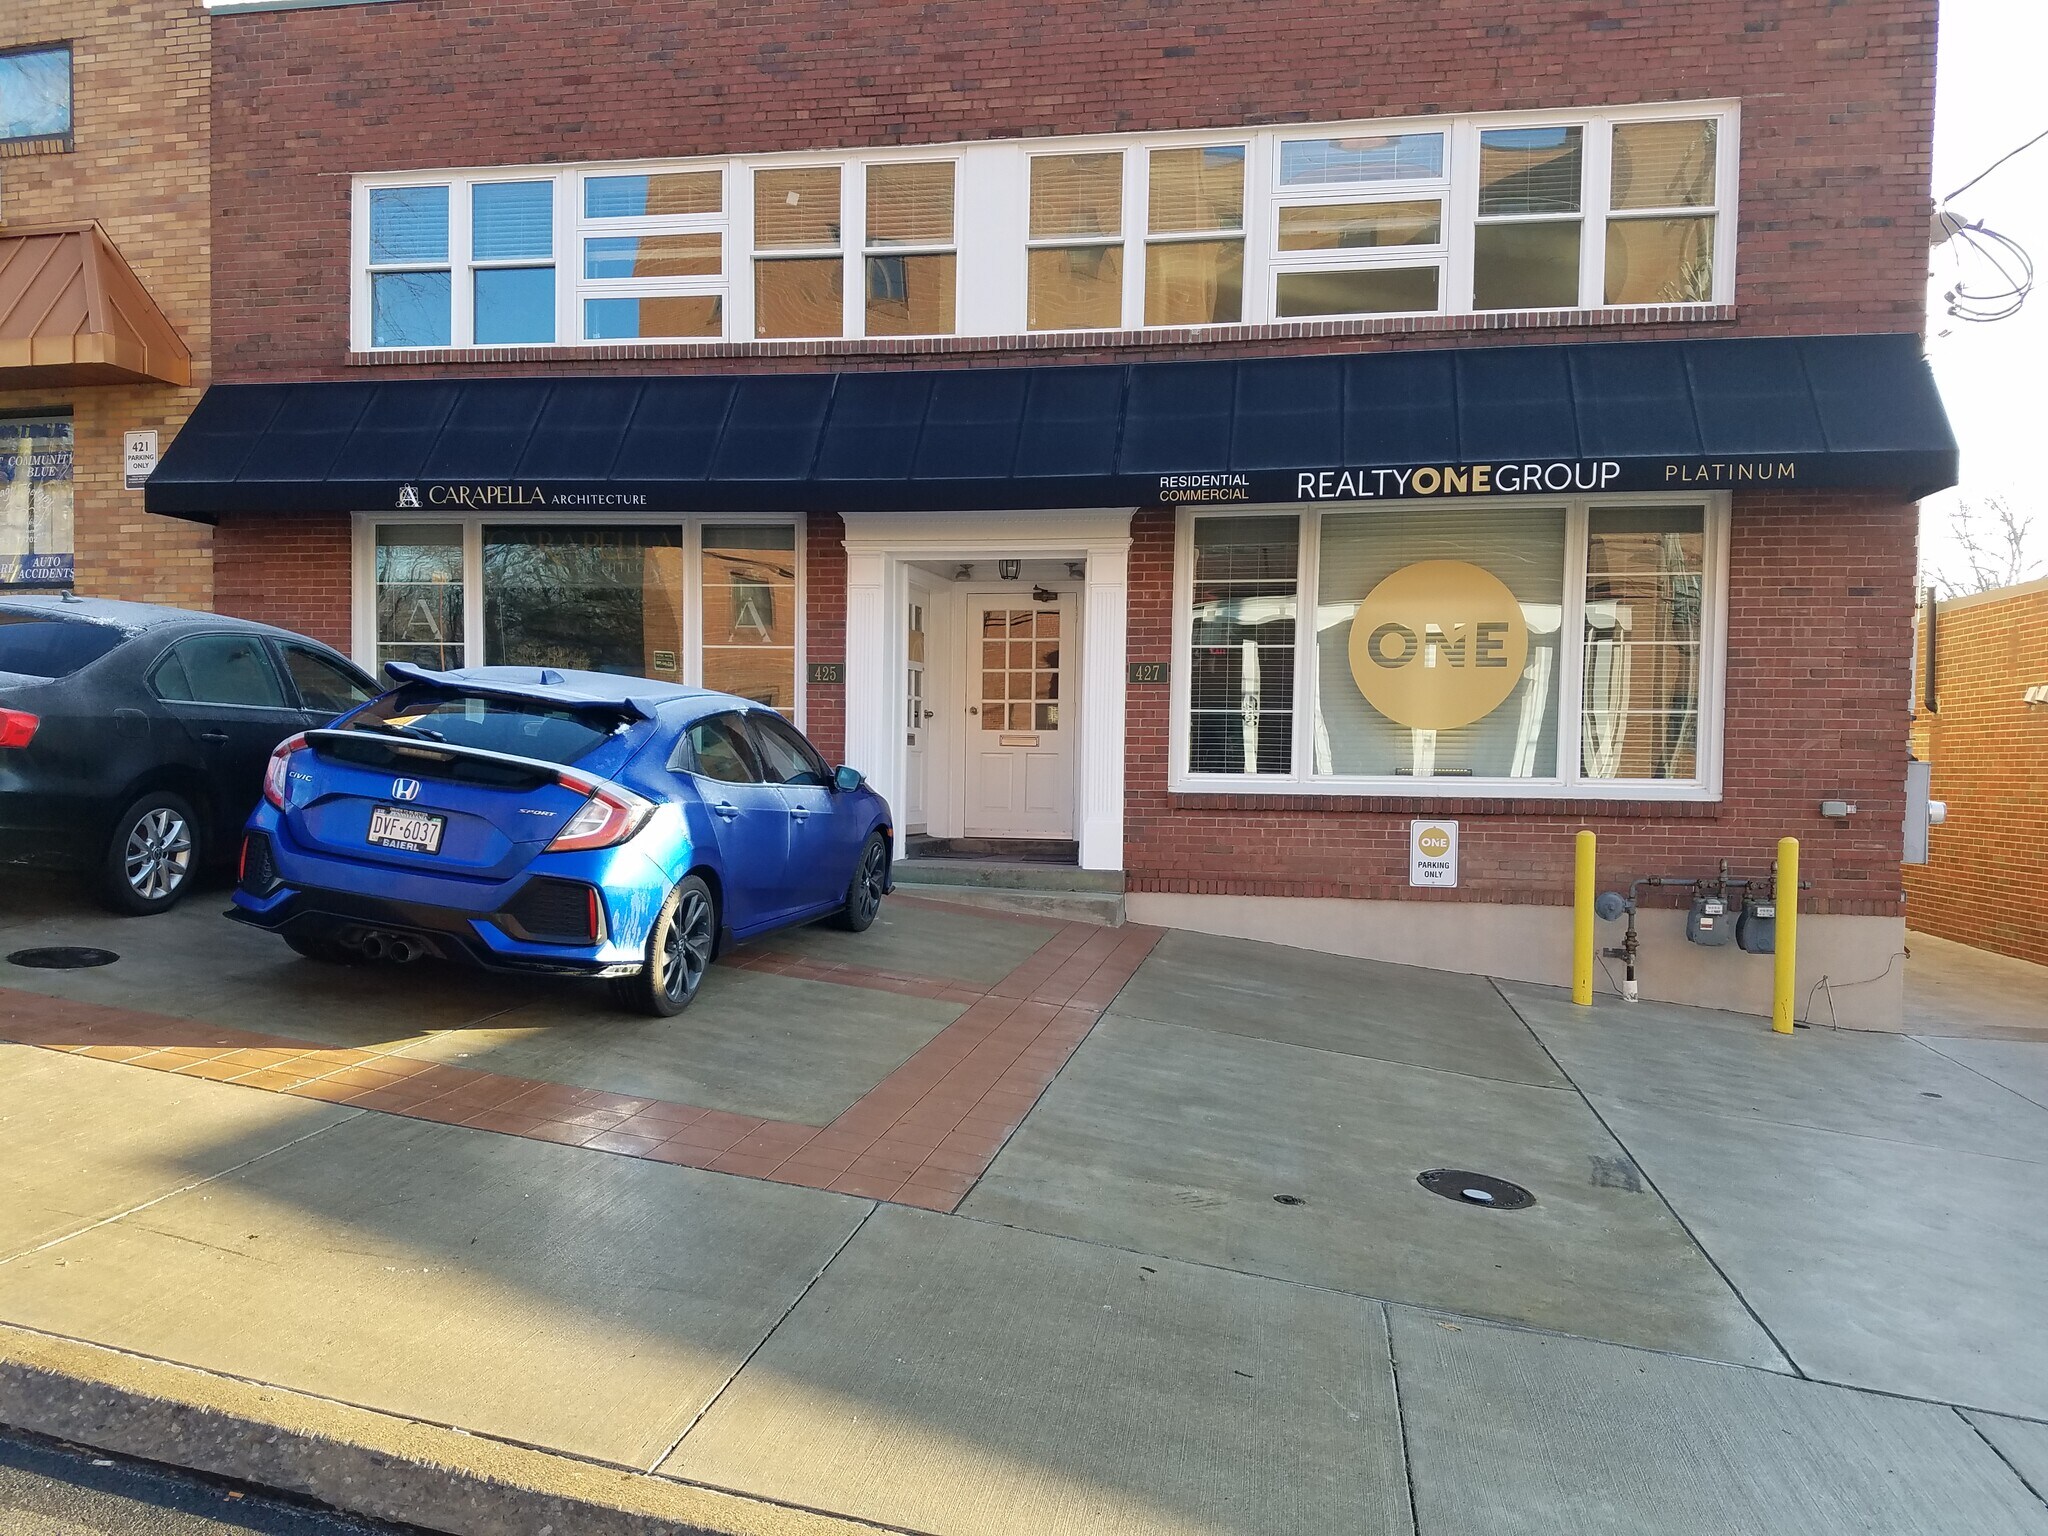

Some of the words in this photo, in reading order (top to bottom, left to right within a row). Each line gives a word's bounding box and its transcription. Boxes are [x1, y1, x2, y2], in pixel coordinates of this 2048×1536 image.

[132, 441, 149, 452] 421
[27, 466, 56, 477] BLUE
[1666, 463, 1796, 481] PLATINUM
[1160, 474, 1250, 488] RESIDENTIAL
[429, 485, 546, 510] CARAPELLA
[551, 494, 648, 505] ARCHITECTURE
[1160, 488, 1250, 502] COMMERCIAL
[32, 557, 61, 567] AUTO
[18, 568, 75, 580] ACCIDENTS
[1368, 622, 1509, 669] ONE
[814, 665, 837, 681] 425
[1135, 665, 1160, 681] 427
[289, 771, 313, 782] CIVIC
[518, 808, 558, 817] SPORT
[382, 838, 420, 852] BAIERL
[1421, 837, 1448, 848] ONE
[1417, 861, 1450, 870] PARKING
[1424, 870, 1444, 879] ONLY
